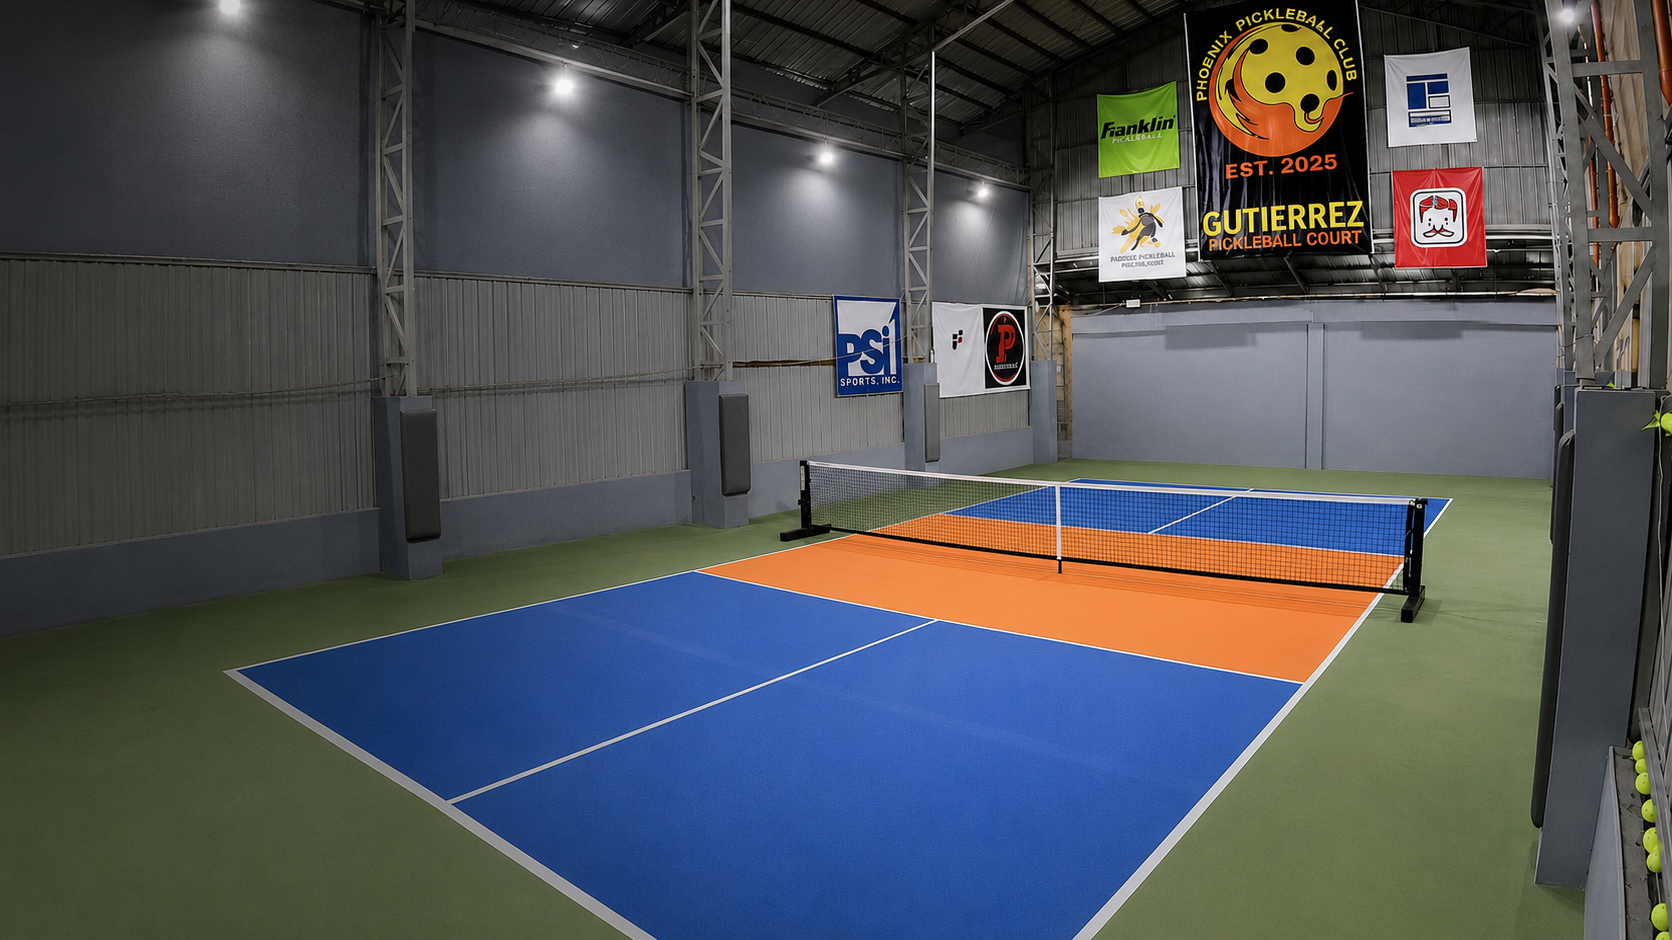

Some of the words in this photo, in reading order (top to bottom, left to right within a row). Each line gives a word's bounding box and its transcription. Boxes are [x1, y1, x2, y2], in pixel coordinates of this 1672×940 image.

[1196, 30, 1233, 102] PHOENIX
[1235, 8, 1334, 40] PICKLEBALL
[1333, 38, 1358, 81] CLUB
[1100, 115, 1176, 139] Franklin
[1225, 160, 1274, 179] EST.
[1280, 153, 1338, 174] 2025
[1202, 200, 1365, 237] GUTIERREZ
[1208, 233, 1302, 252] PICKLEBALL
[1306, 230, 1363, 246] COURT
[881, 376, 900, 385] INC.
